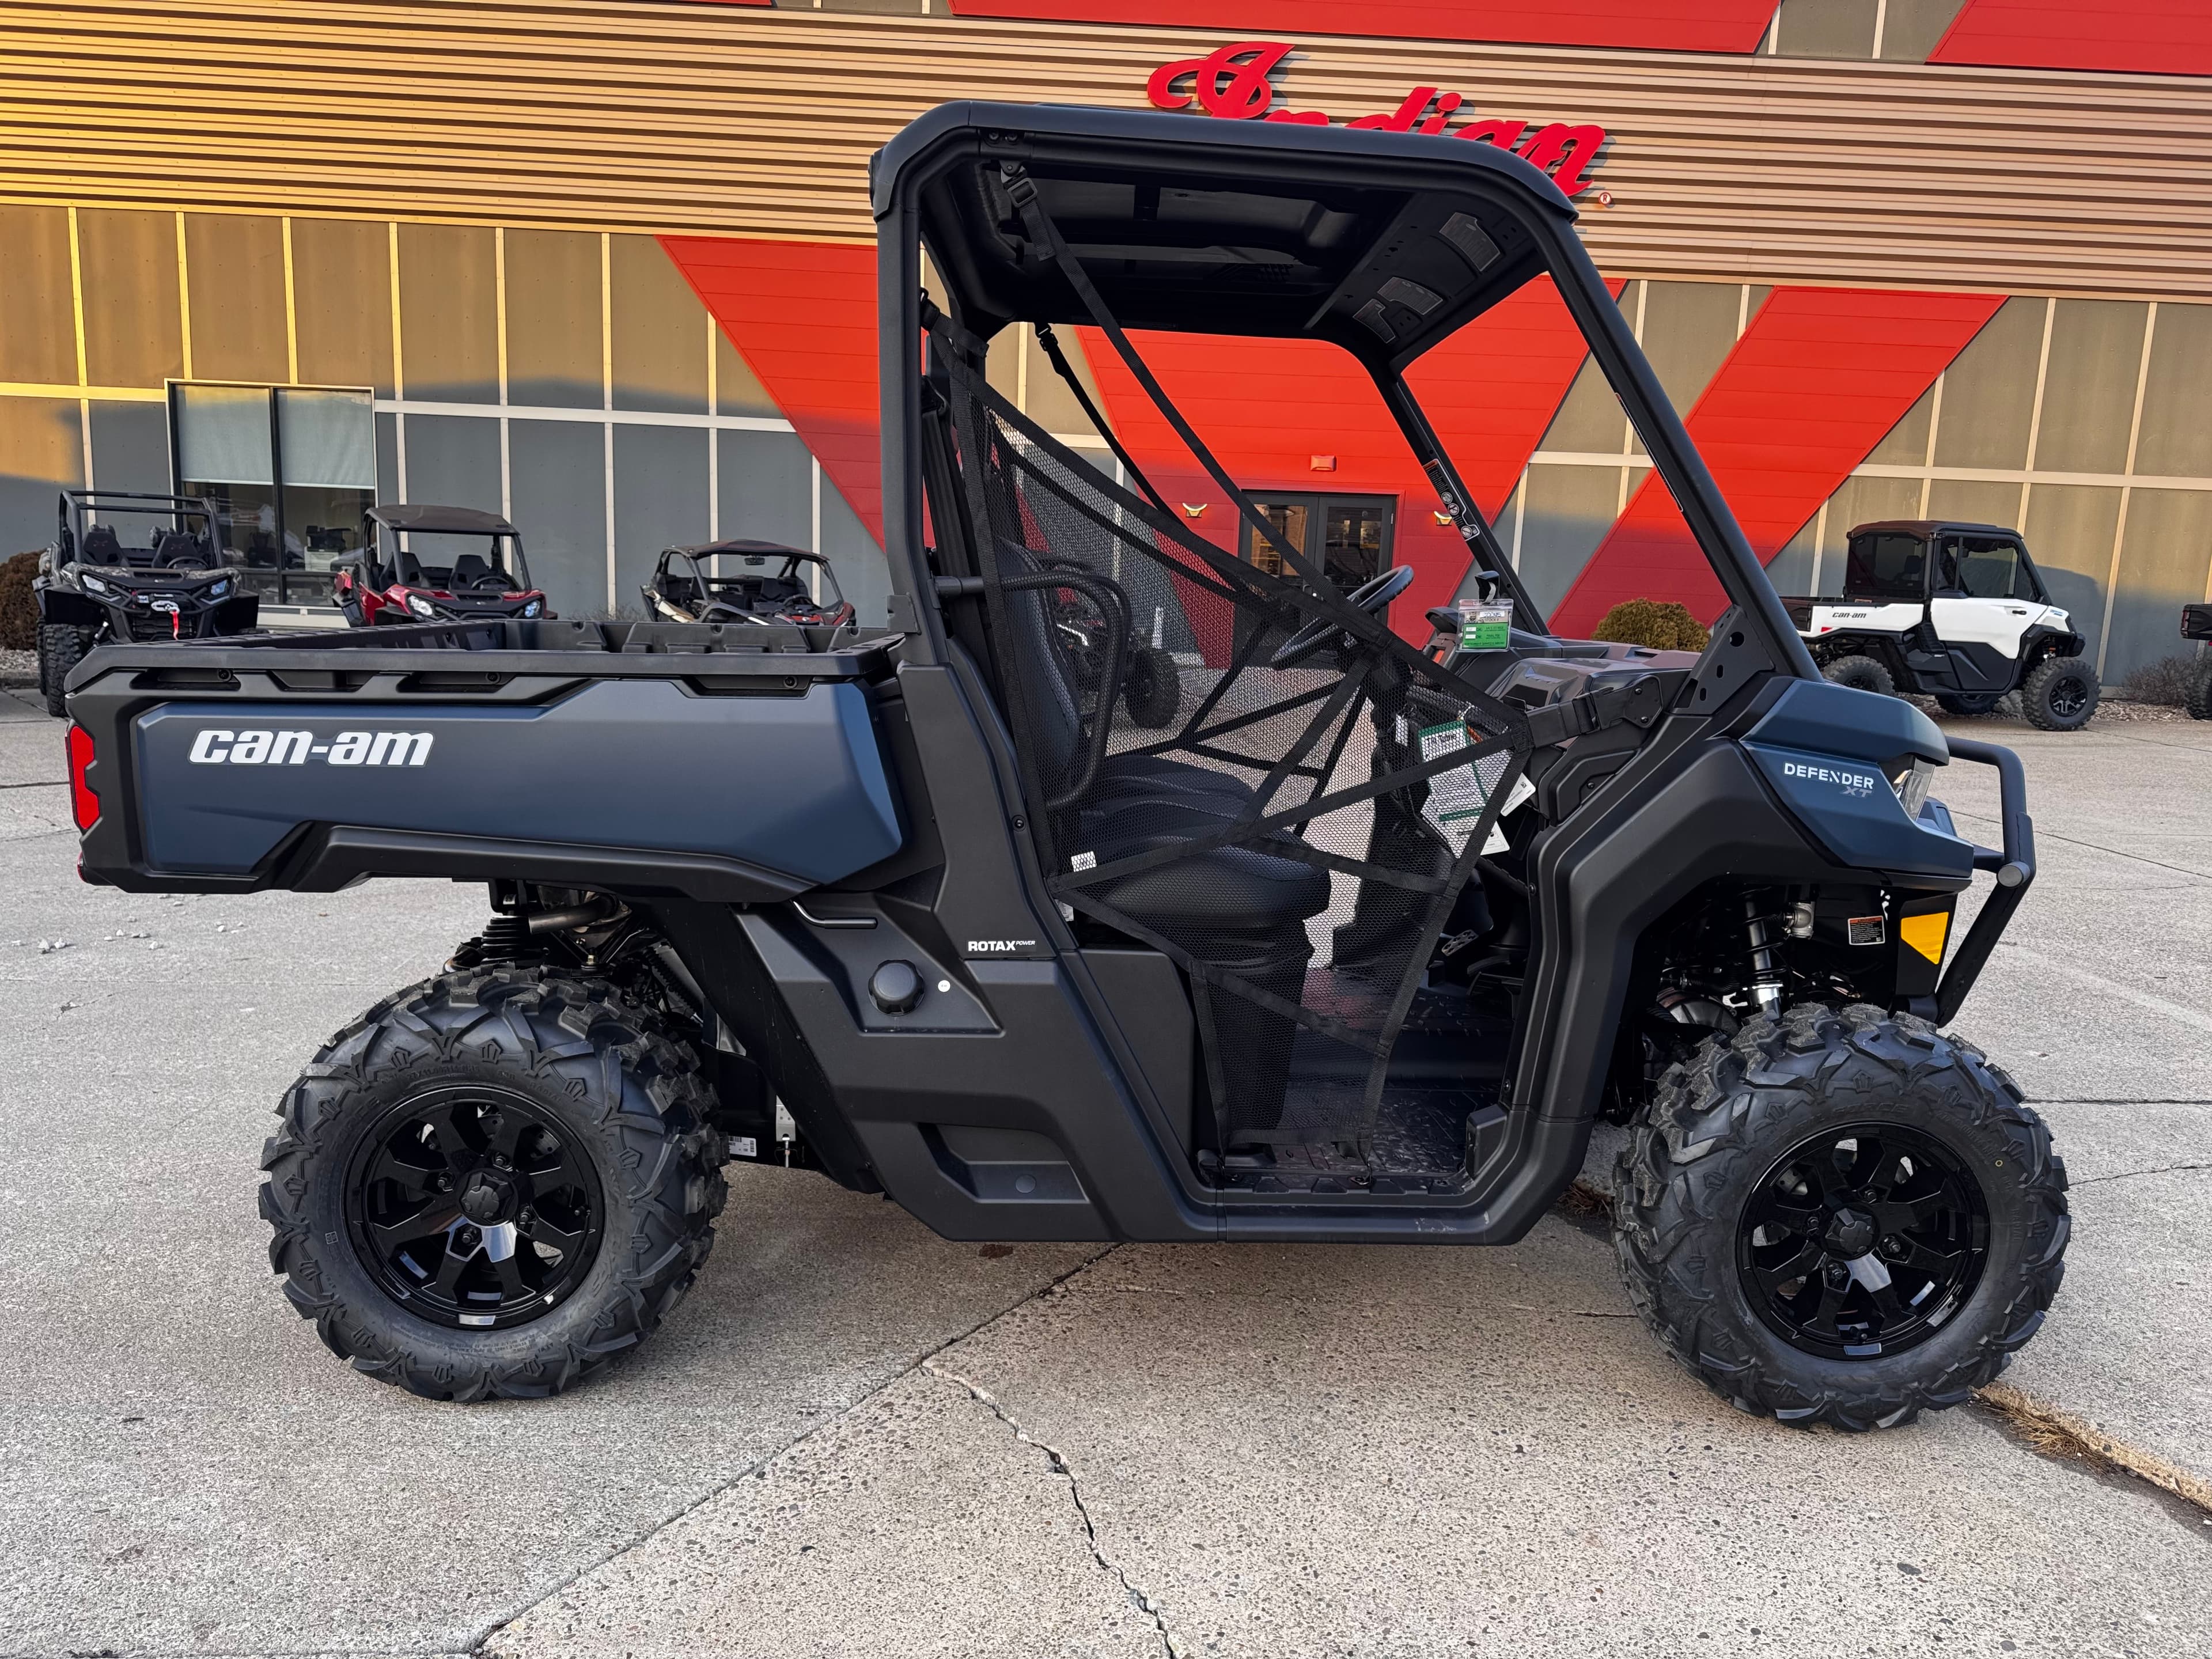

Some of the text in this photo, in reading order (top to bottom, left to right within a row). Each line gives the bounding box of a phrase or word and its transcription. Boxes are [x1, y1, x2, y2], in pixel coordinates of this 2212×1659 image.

[1146, 41, 1607, 197] Idian
[190, 729, 434, 766] can-am
[1783, 762, 1874, 790] DEFENDER
[1842, 786, 1873, 798] XT
[968, 940, 1016, 952] ROTAX
